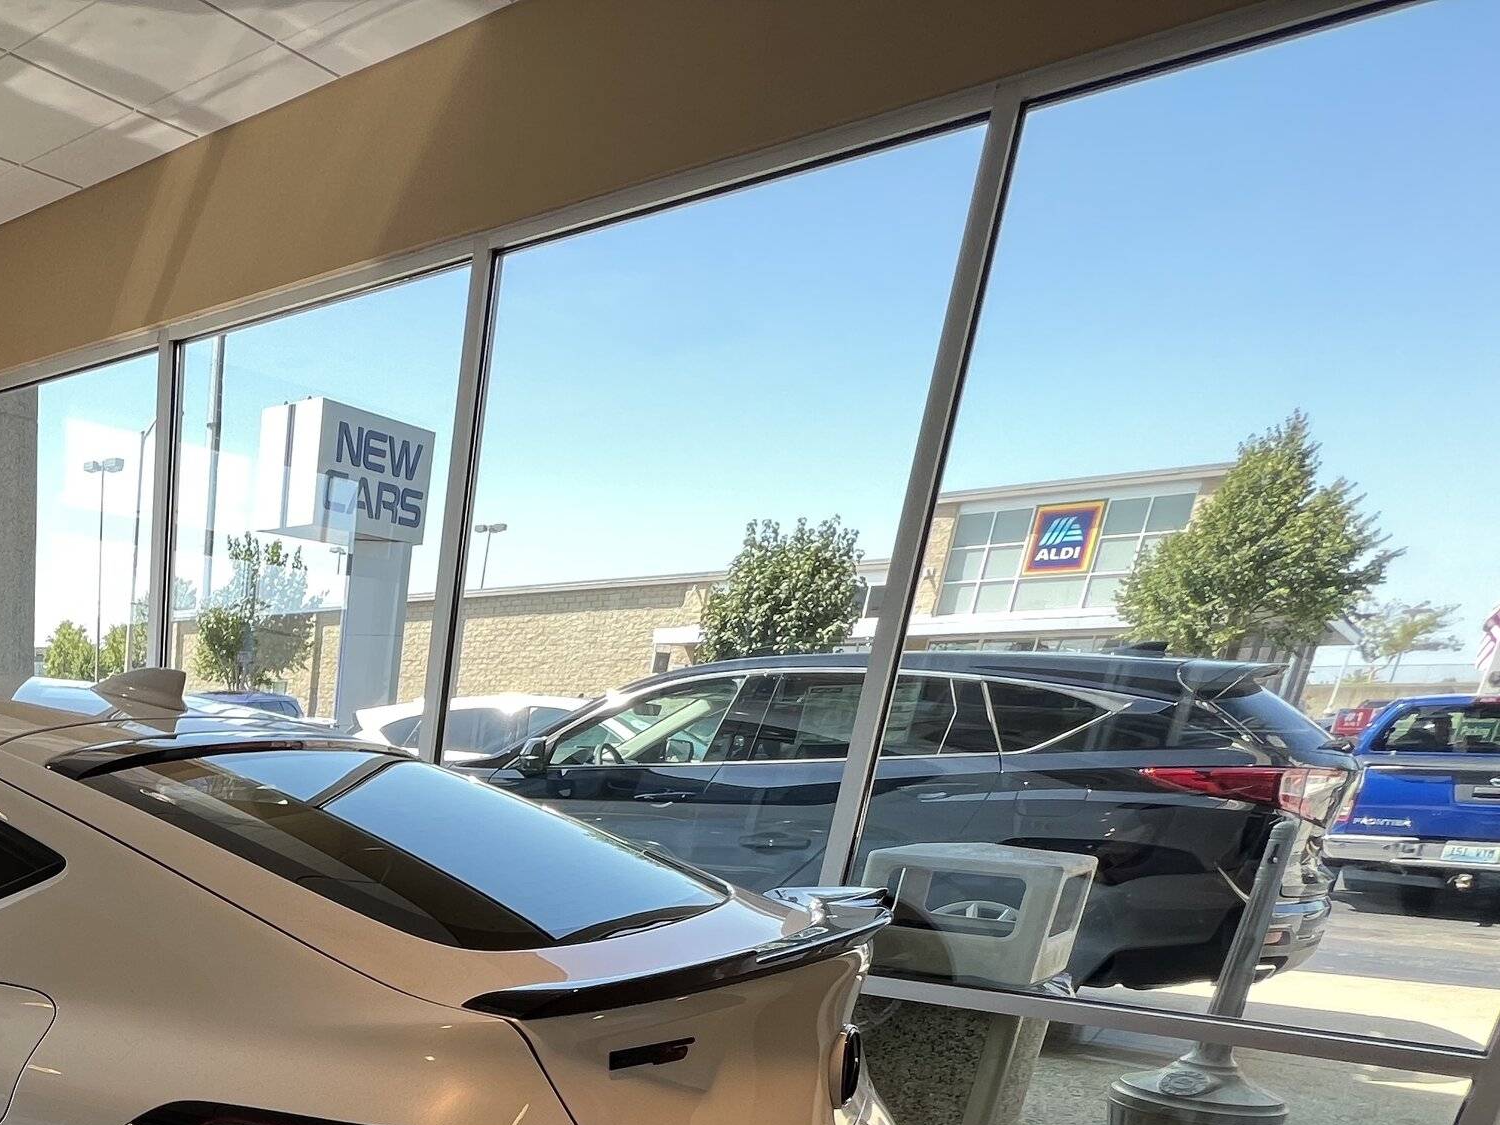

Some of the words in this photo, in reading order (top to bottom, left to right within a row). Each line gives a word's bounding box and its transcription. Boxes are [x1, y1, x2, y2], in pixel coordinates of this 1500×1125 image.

[336, 421, 423, 480] NEW
[324, 469, 423, 528] CARS
[1034, 547, 1081, 561] ALDI
